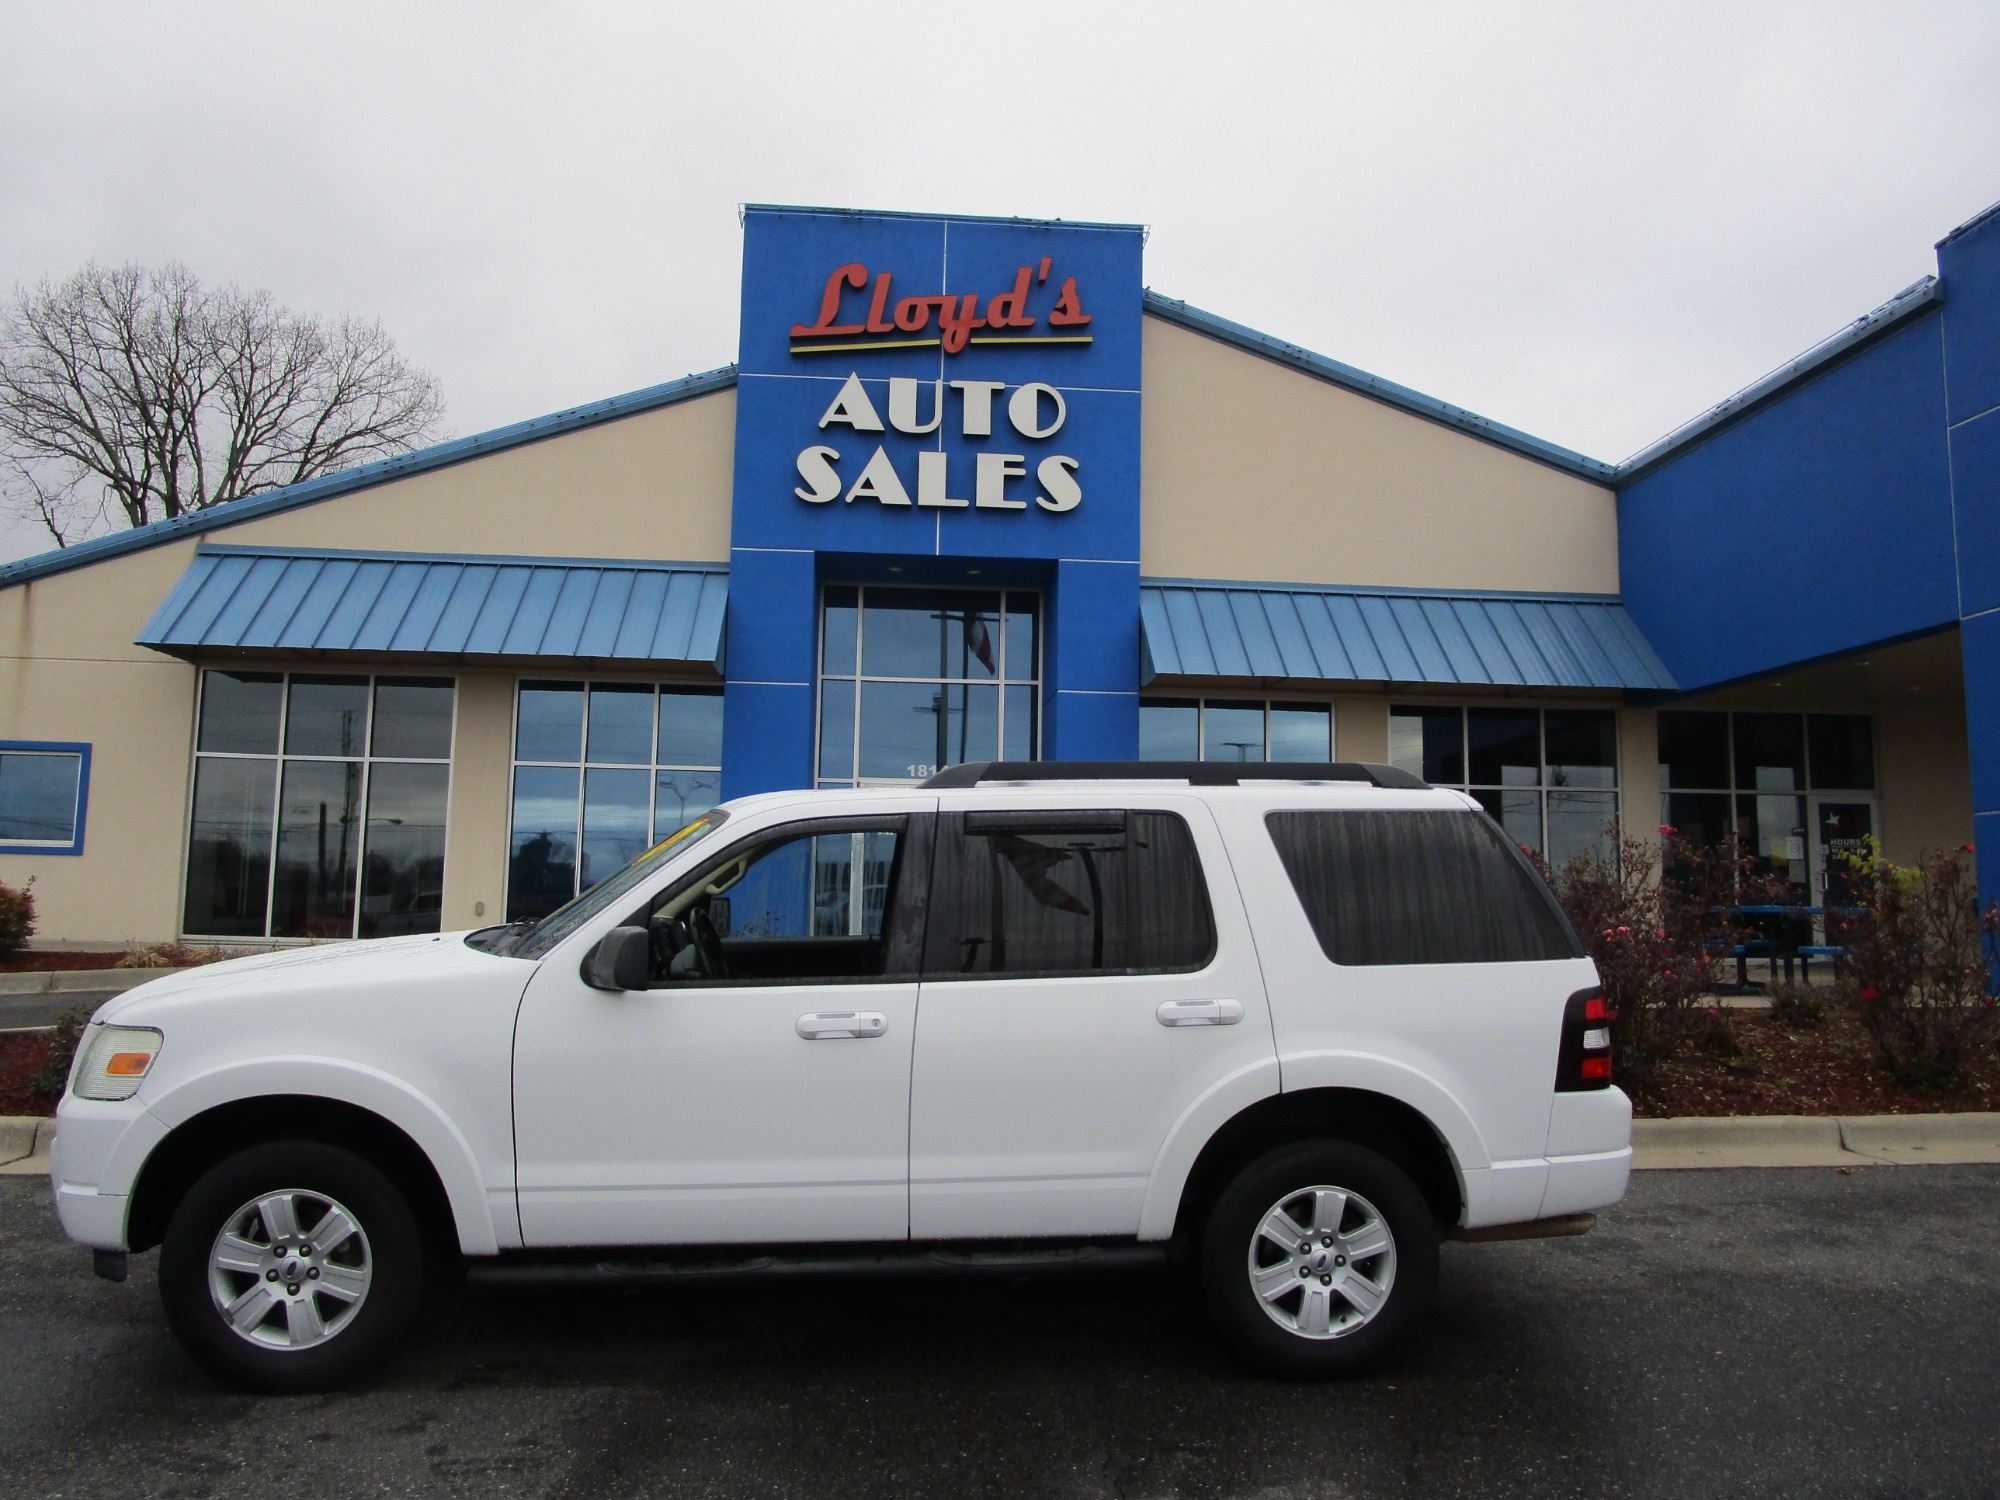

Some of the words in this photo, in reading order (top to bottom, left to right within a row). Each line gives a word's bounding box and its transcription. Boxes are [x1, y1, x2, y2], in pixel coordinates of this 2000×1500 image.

[789, 256, 1093, 354] Lloyd's
[818, 371, 1066, 439] AUTO
[794, 445, 1082, 512] SALES
[1830, 838, 1861, 846] HOURS
